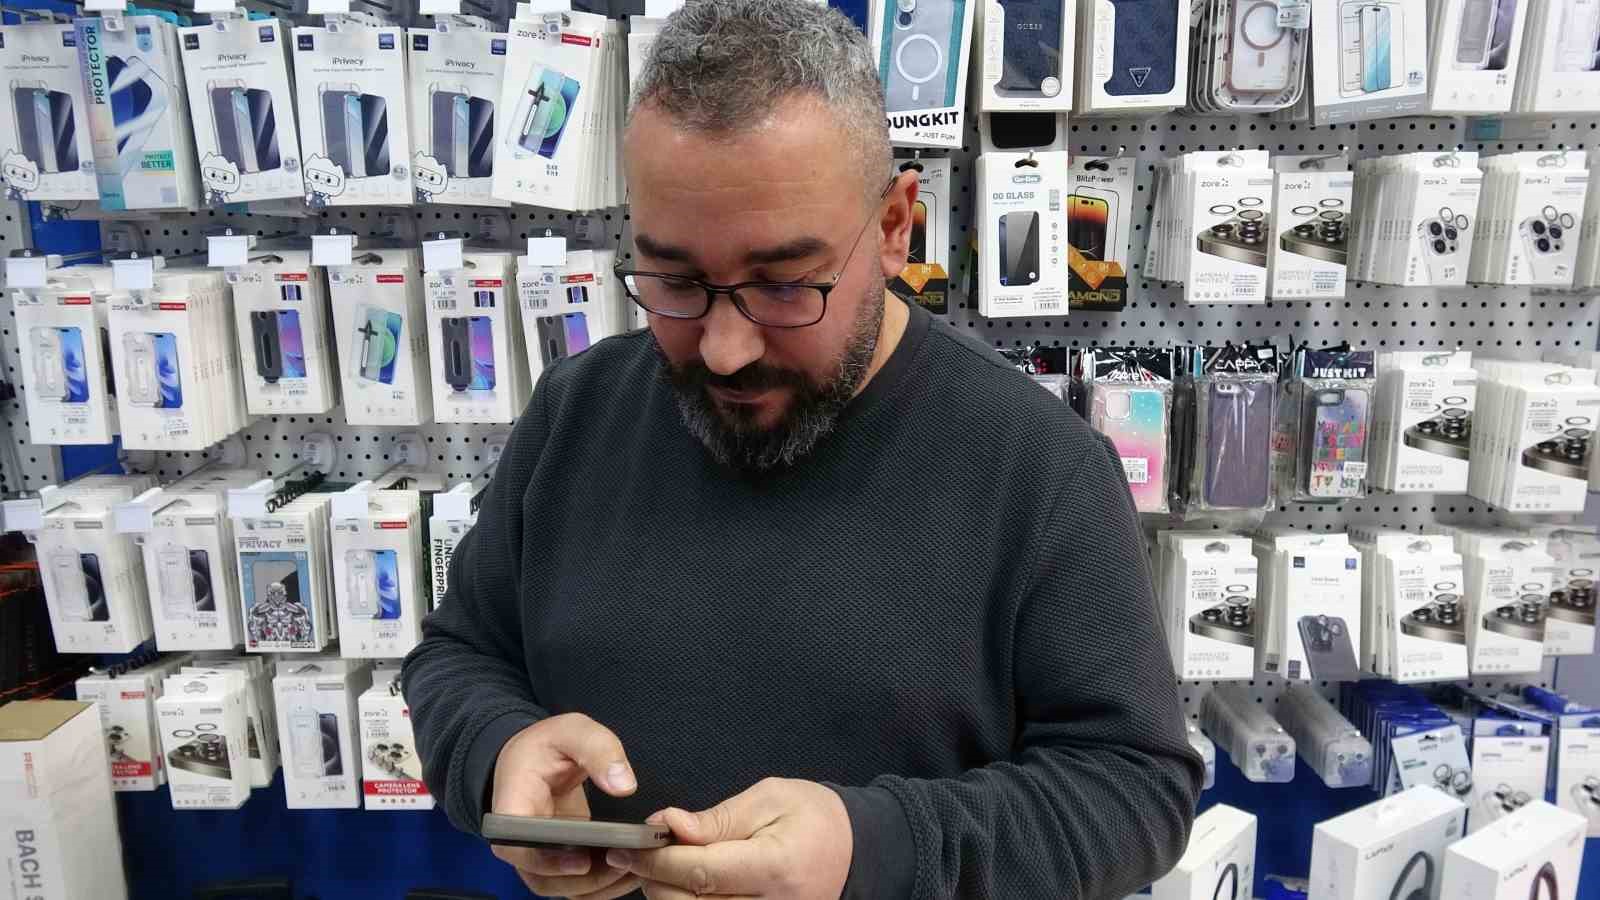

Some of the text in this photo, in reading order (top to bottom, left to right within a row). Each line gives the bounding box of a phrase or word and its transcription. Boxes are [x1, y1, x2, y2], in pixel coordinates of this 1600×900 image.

[85, 25, 105, 105] PROTECTOR
[332, 57, 365, 66] iPrivacy
[444, 59, 476, 68] iPrivacy
[140, 160, 172, 168] BETTER
[15, 829, 43, 889] BACH
